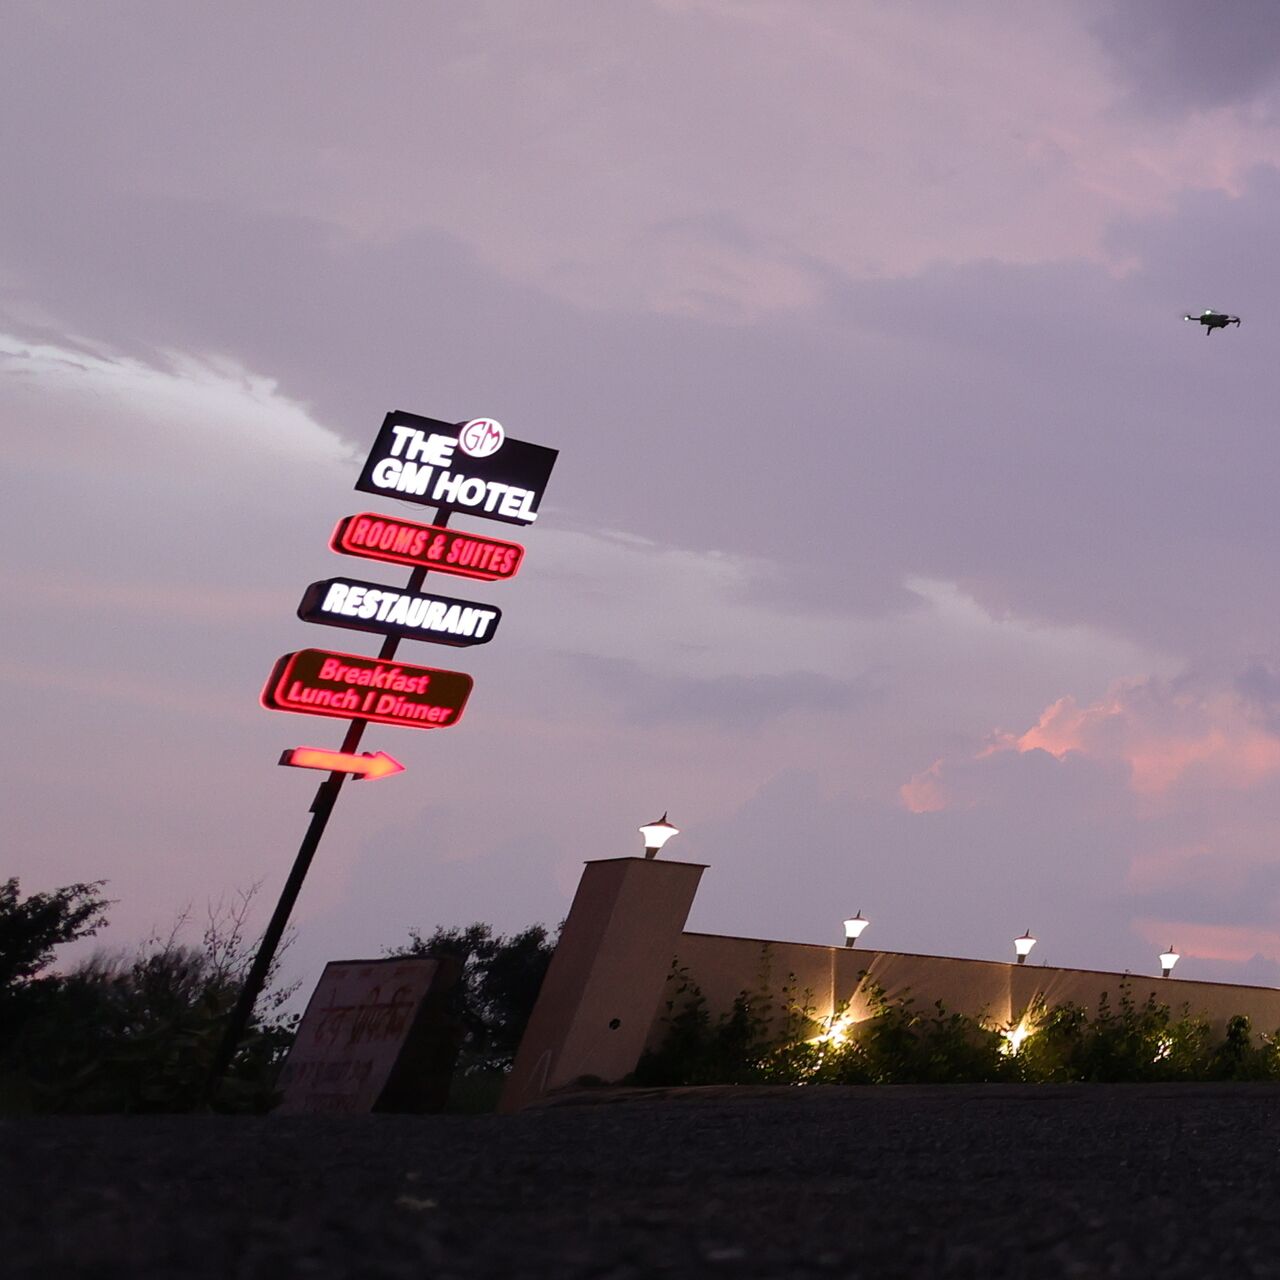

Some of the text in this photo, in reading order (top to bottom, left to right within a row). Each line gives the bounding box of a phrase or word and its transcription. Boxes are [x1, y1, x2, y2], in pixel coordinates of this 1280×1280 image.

[390, 425, 459, 468] THE
[371, 457, 538, 521] GM HOTEL
[351, 518, 517, 574] ROOMS & SUITES
[321, 582, 496, 638] RESTAURANT
[318, 658, 431, 695] Breakfast
[287, 681, 360, 710] Lunch
[375, 694, 453, 723] Dinner
